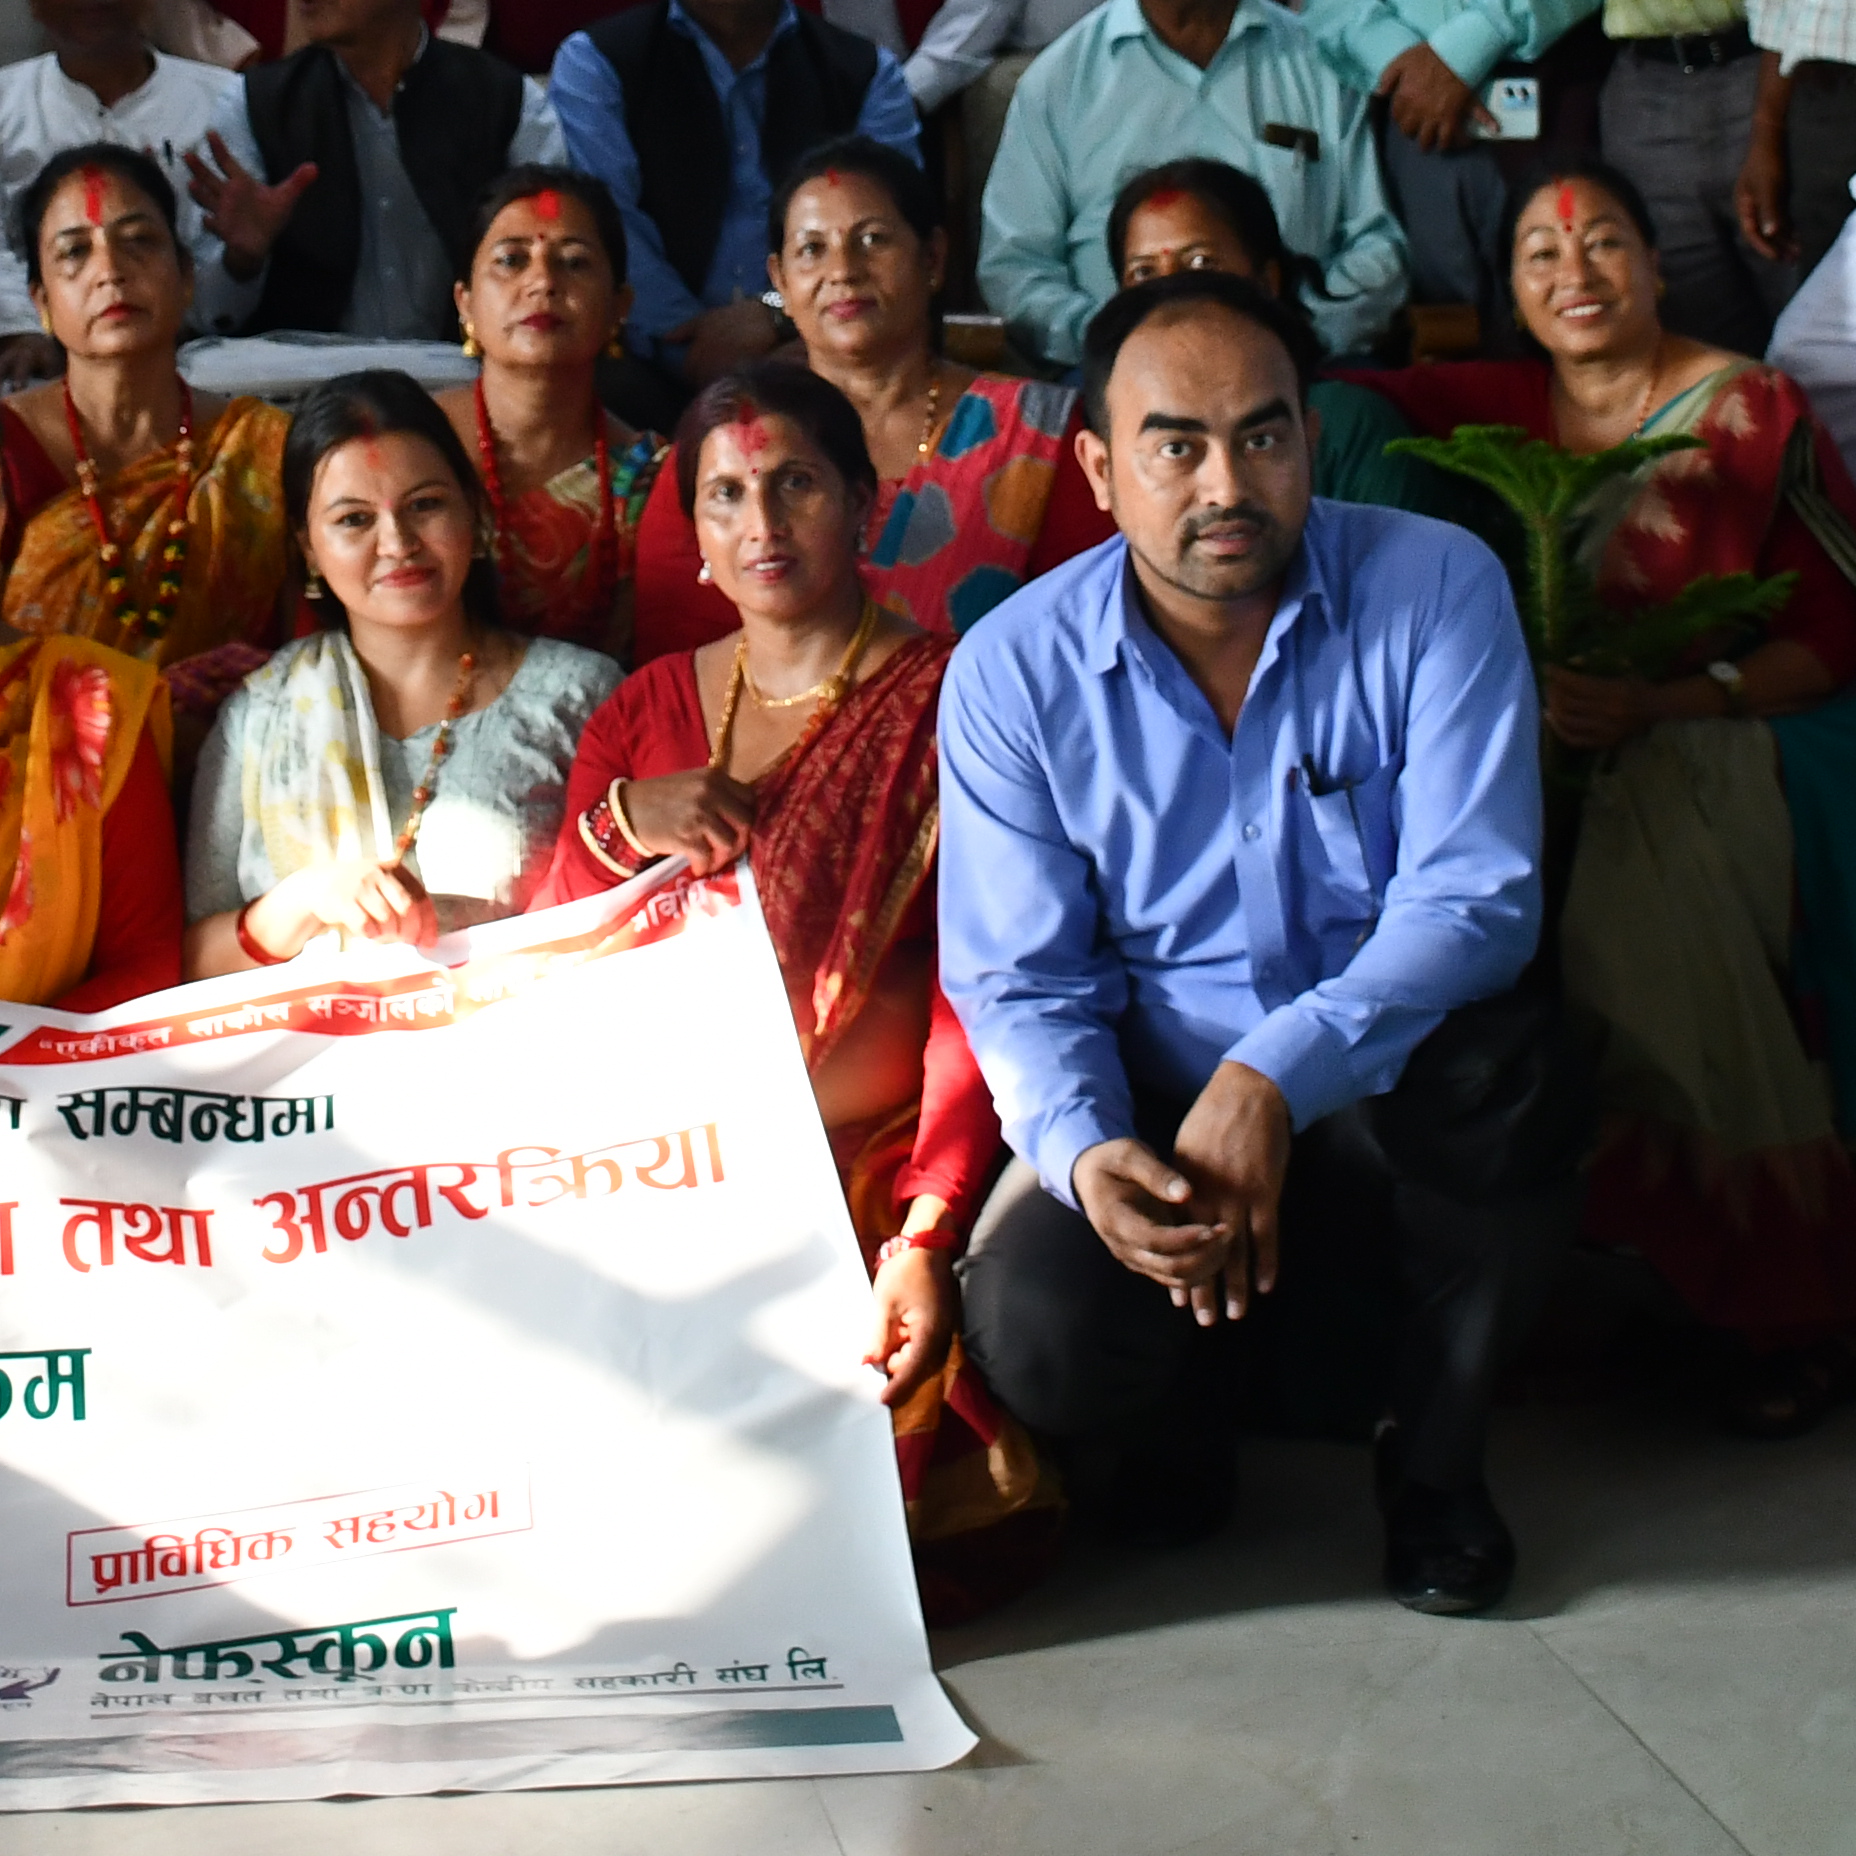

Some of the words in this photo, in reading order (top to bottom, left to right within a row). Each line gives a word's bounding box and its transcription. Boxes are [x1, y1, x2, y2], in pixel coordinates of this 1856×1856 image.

[56, 1086, 335, 1144] सम्बन्धमा
[59, 1197, 215, 1273] तथा
[253, 1122, 726, 1264] अन्तरक्रिया
[90, 1527, 296, 1594] प्राविधिक
[323, 1490, 500, 1550] सहयोग
[90, 1689, 174, 1708] नेपाल
[193, 1689, 267, 1705] बचत
[574, 1662, 697, 1690] सहकारी
[716, 1659, 771, 1684] संघ
